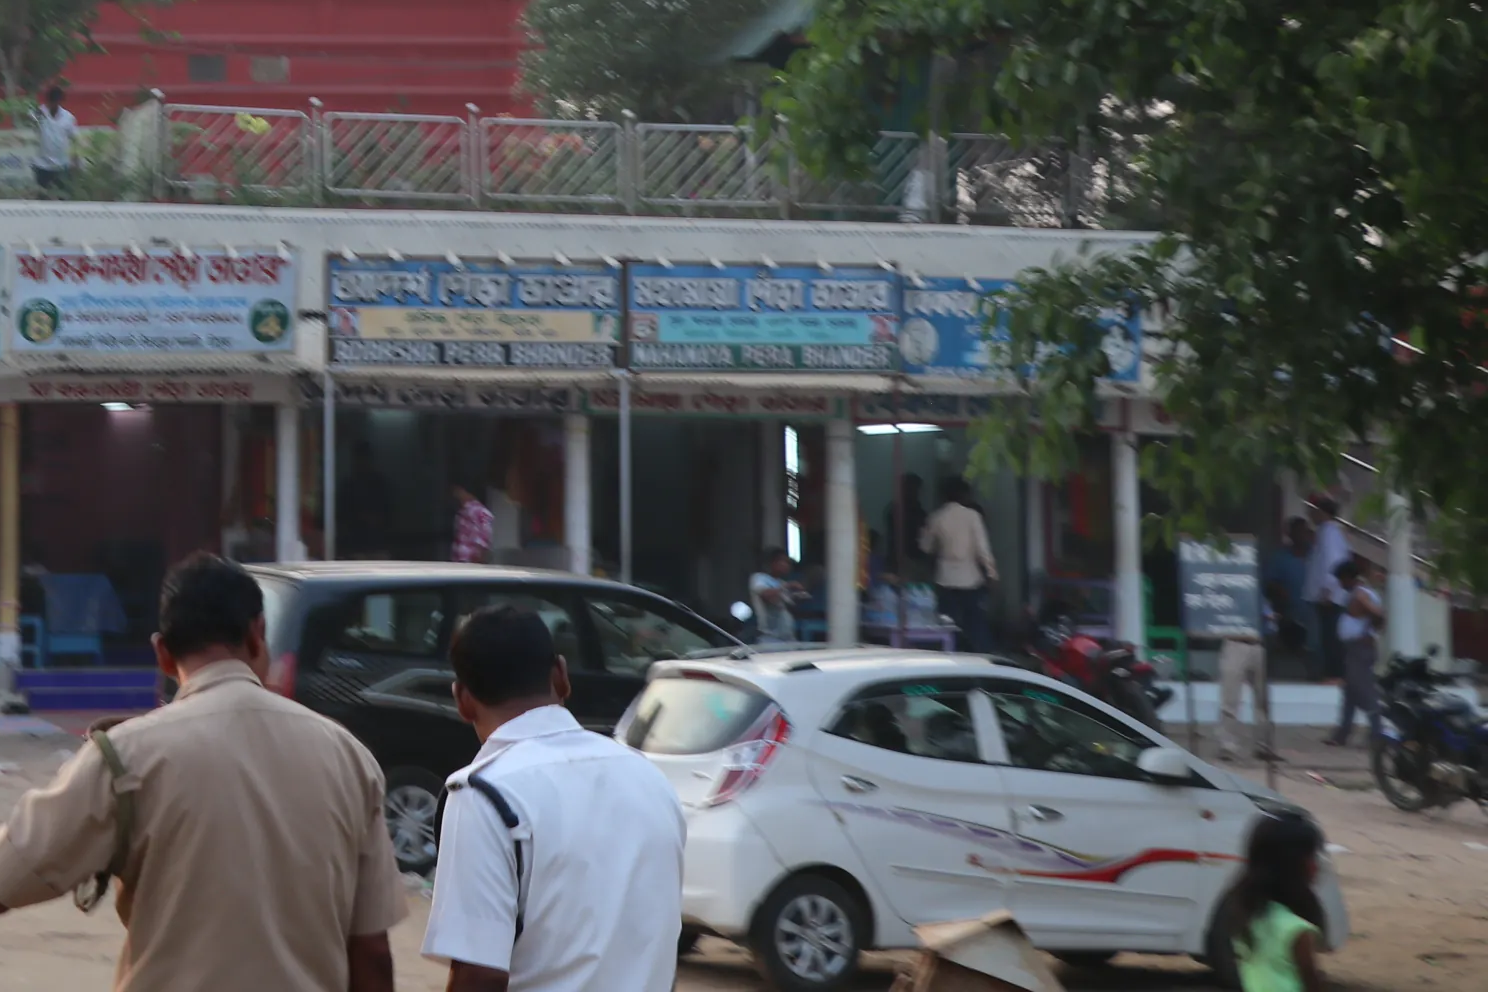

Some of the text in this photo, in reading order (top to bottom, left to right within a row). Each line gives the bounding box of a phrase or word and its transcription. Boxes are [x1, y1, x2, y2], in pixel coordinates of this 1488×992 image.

[443, 342, 505, 365] PERA
[632, 343, 892, 368] MAHAMAYA PERA BHANDER
